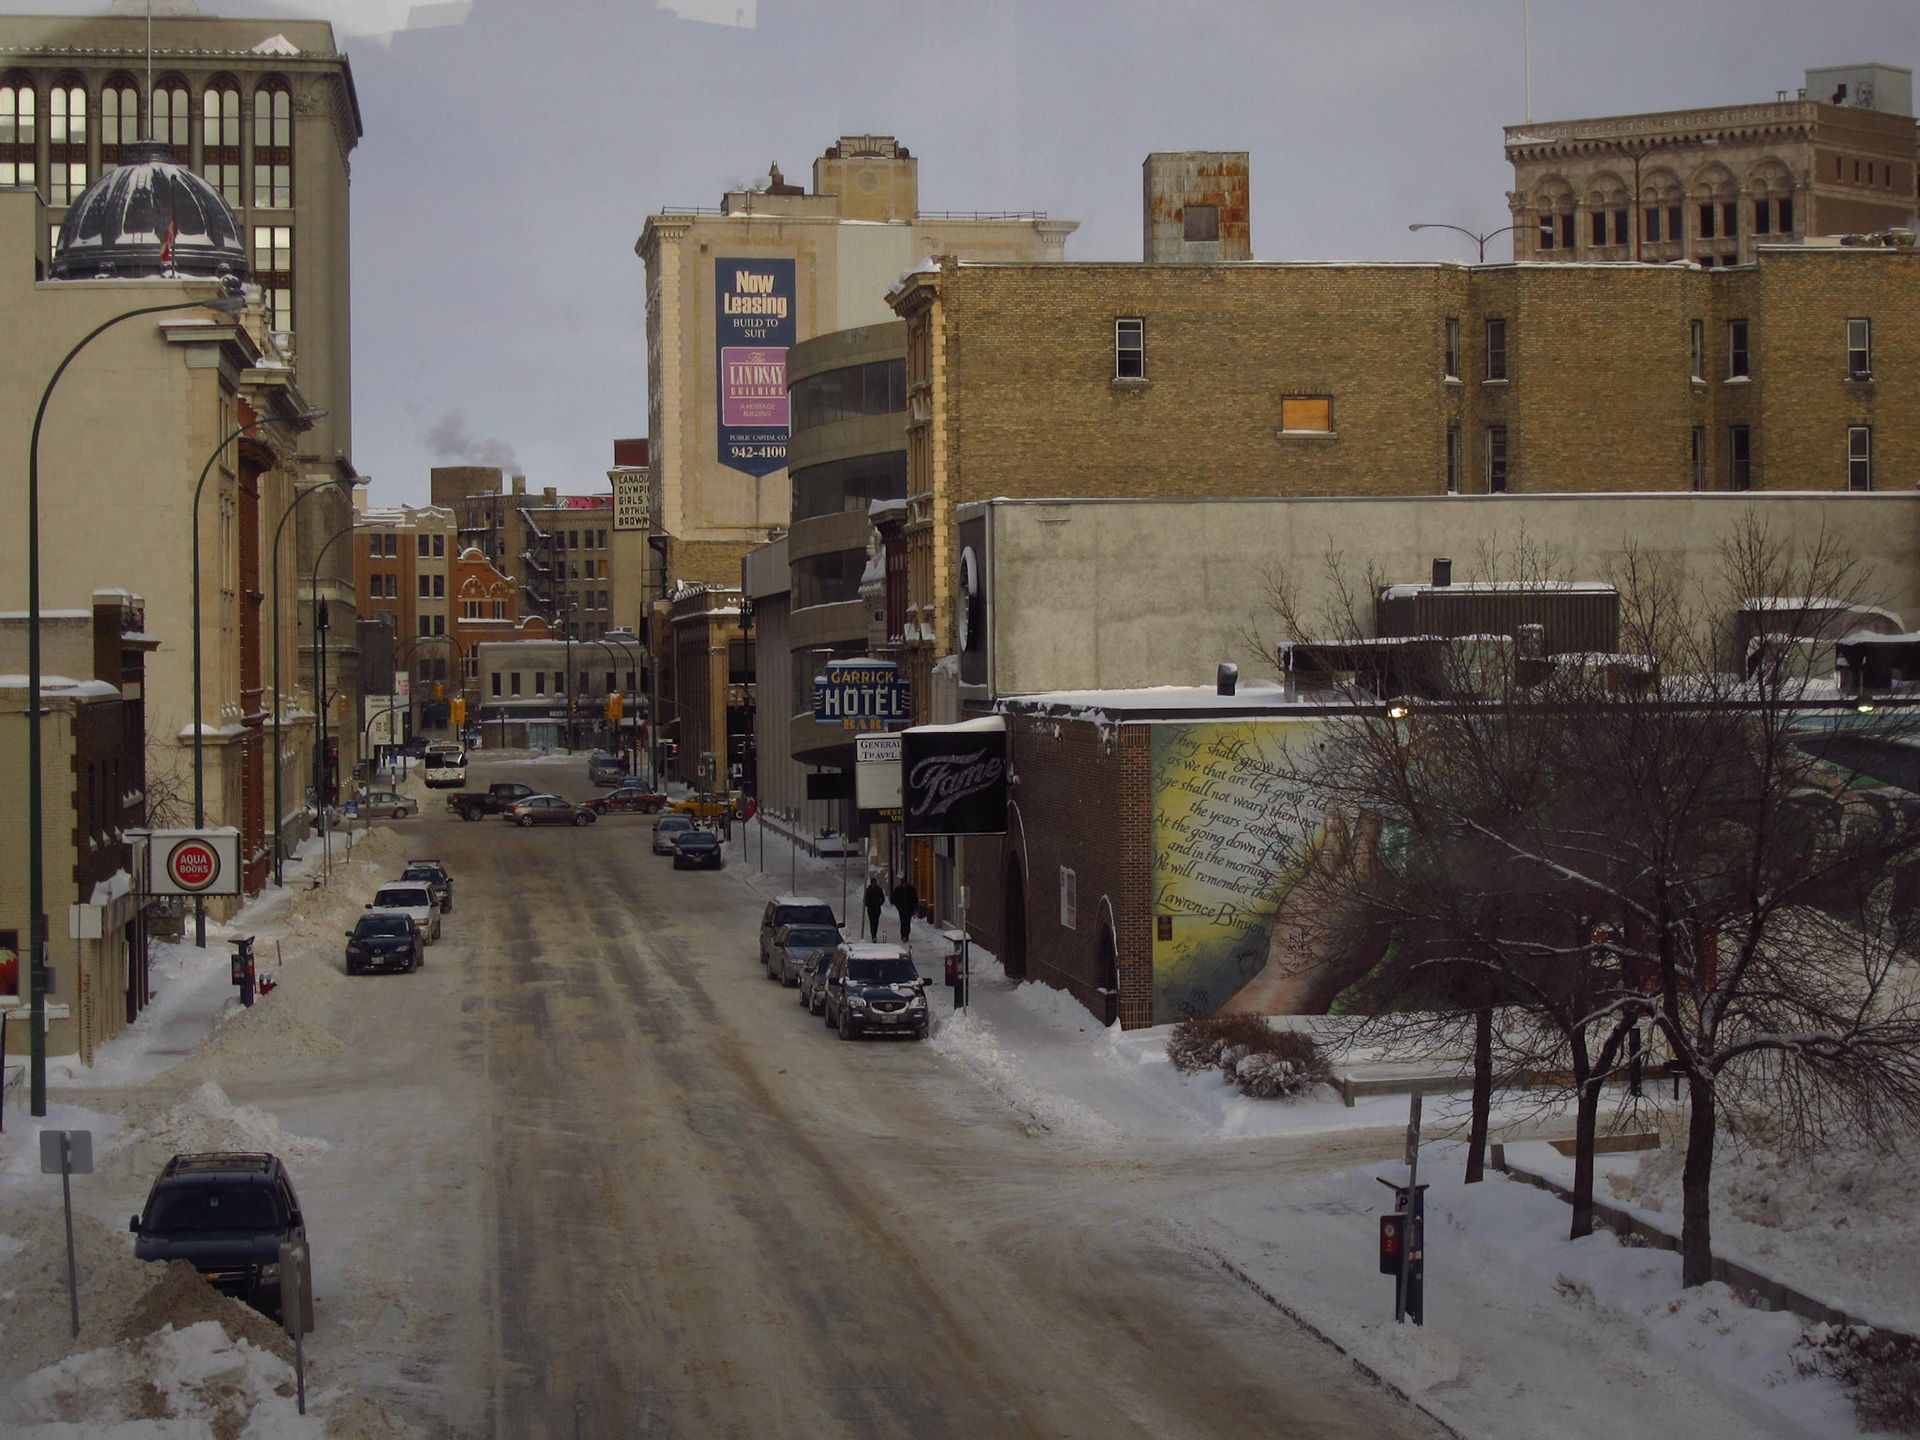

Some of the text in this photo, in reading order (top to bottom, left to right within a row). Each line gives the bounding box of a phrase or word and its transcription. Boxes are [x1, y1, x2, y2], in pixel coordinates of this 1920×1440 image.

[736, 271, 775, 293] Now
[724, 292, 788, 318] Leasing
[733, 318, 779, 327] BUILD TO
[744, 329, 767, 338] SUIT
[729, 366, 784, 385] LINDSAY
[731, 387, 783, 396] BUILDING
[731, 446, 787, 458] 942-4100
[619, 496, 643, 505] GIRLS
[831, 670, 895, 684] GARRICK
[825, 689, 903, 716] HOTEL
[842, 718, 882, 730] BAR
[1167, 725, 1202, 758] They
[1205, 736, 1251, 761] shall
[862, 751, 897, 760] TRAVEL
[909, 746, 1003, 816] Fame
[1167, 756, 1181, 767] as
[1203, 761, 1227, 780] that
[1228, 774, 1248, 786] are
[1250, 772, 1272, 799] left
[1307, 793, 1332, 811] old
[1153, 765, 1320, 829] Age shall not weary them nor
[1190, 799, 1209, 817] the
[1198, 810, 1241, 828] years
[1152, 807, 1170, 830] At
[1171, 815, 1191, 834] the
[1186, 829, 1225, 851] going
[1226, 831, 1257, 854] down
[180, 854, 208, 865] AQUA
[1168, 841, 1202, 857] and
[1191, 846, 1206, 860] in
[1205, 848, 1228, 866] the
[1225, 859, 1274, 886] morning
[180, 865, 208, 874] BOOKS
[1152, 850, 1169, 871] We
[1171, 860, 1202, 878] will
[1195, 871, 1250, 895] remember
[1153, 882, 1216, 917] Lawrence
[1209, 901, 1266, 942] Binyon
